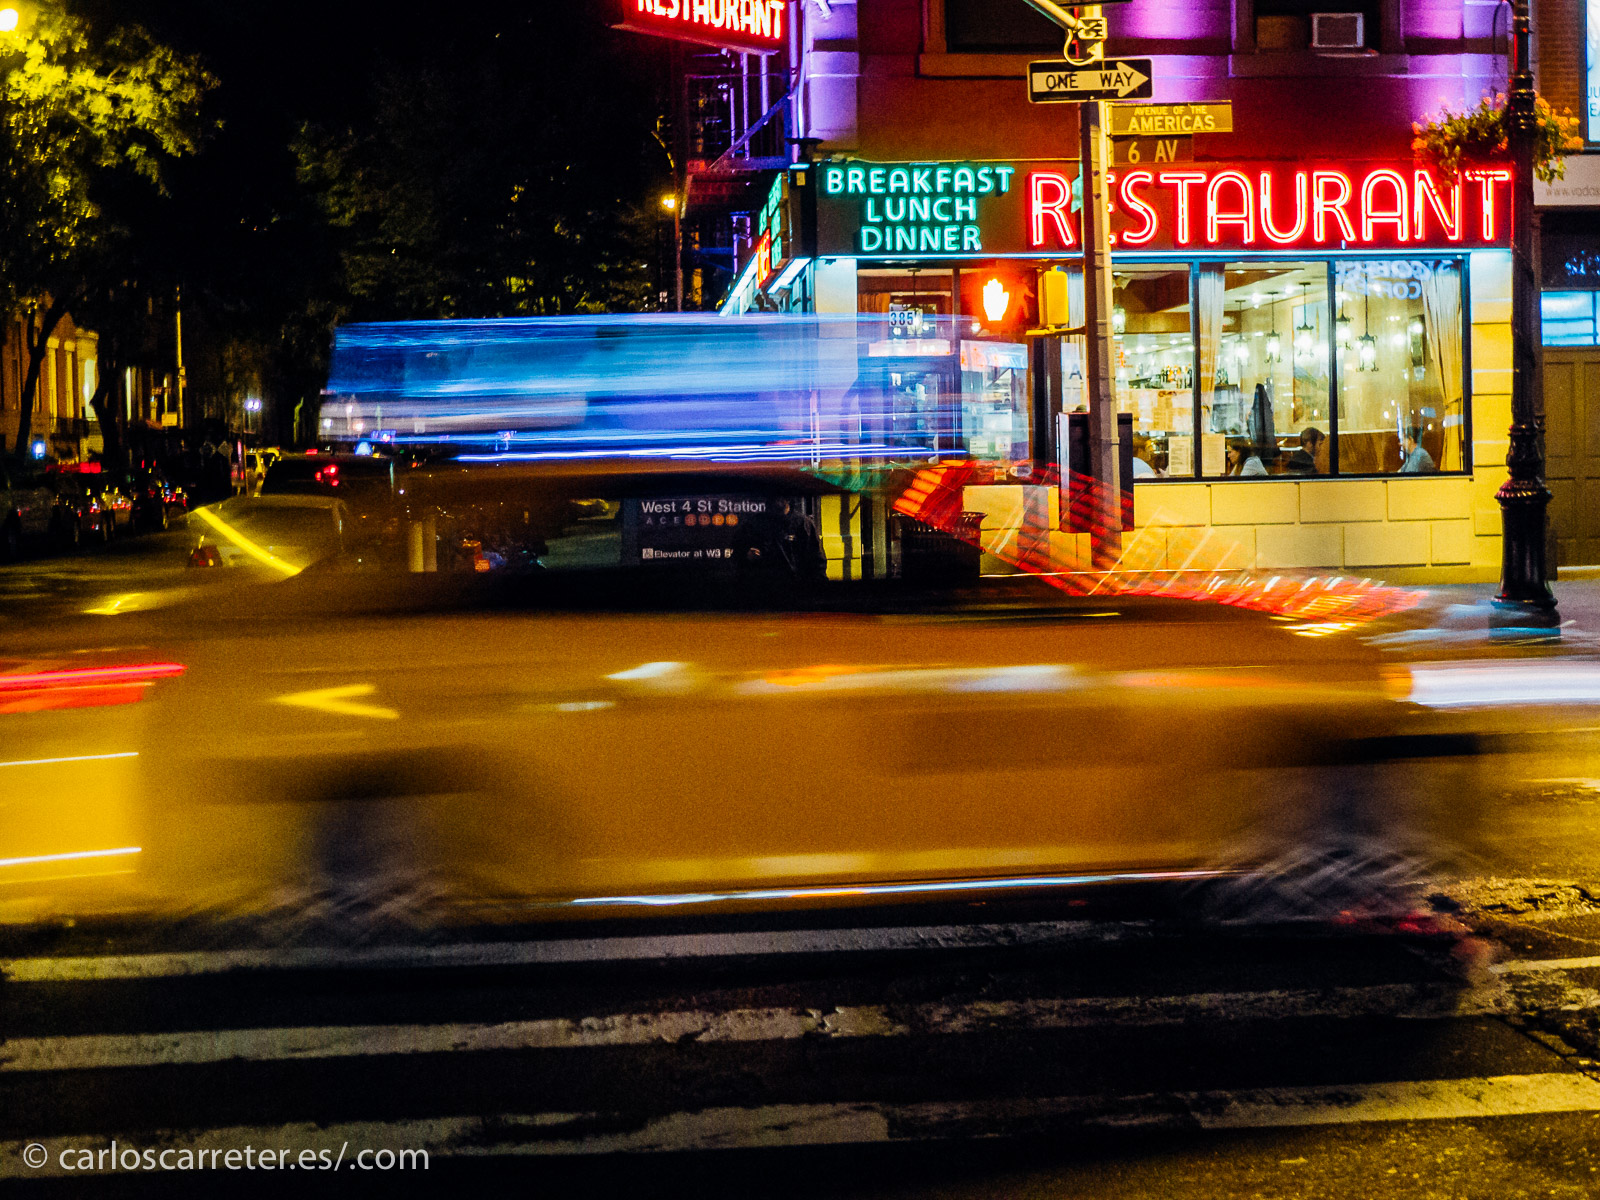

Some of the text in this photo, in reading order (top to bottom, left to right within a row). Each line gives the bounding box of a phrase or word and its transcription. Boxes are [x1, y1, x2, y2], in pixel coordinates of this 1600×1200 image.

[1045, 72, 1135, 90] ONE WAY
[1134, 105, 1208, 116] AVENUE OF THE
[1128, 115, 1216, 132] AMERICAS
[1128, 140, 1178, 164] 6 AV
[826, 166, 1014, 195] BREAKFAST
[865, 197, 977, 223] LUNCH
[1031, 169, 1511, 247] RSTAURANT
[860, 225, 982, 252] DINNER
[890, 312, 914, 326] 385
[641, 500, 766, 513] West 4 St Station
[654, 548, 691, 559] Elevator
[693, 549, 703, 558] at
